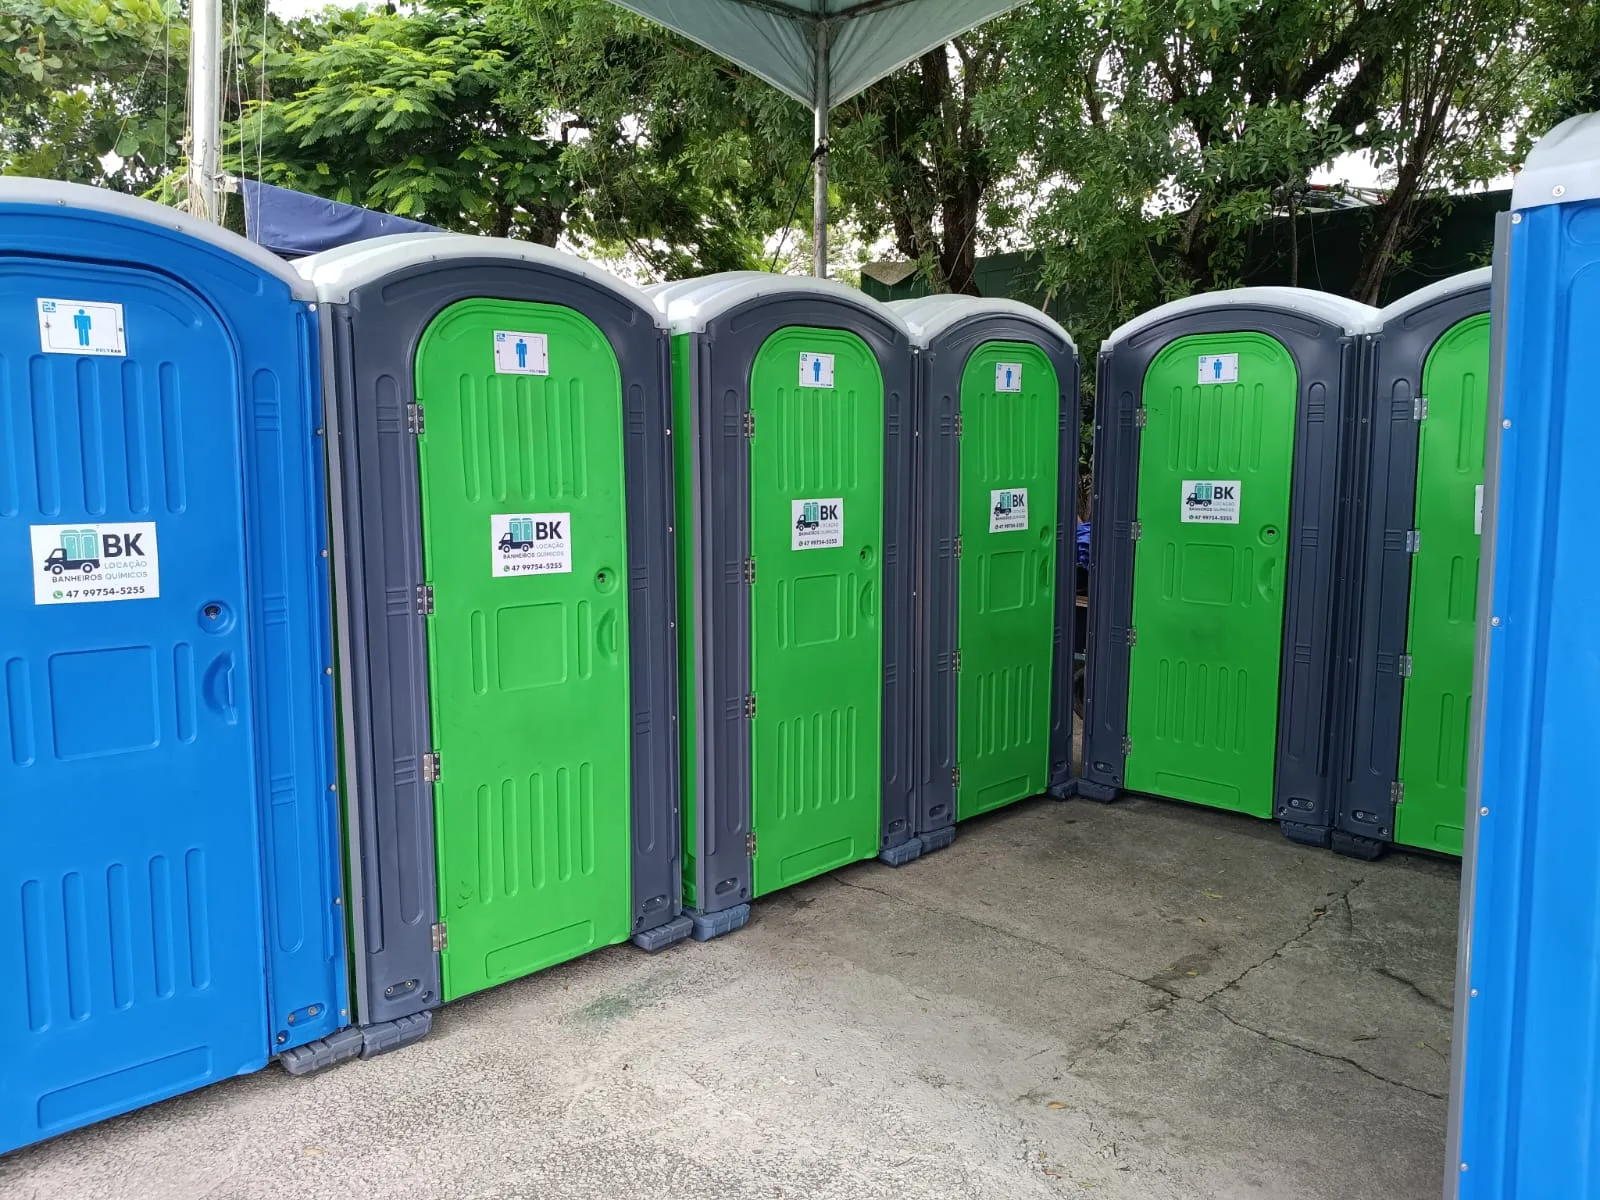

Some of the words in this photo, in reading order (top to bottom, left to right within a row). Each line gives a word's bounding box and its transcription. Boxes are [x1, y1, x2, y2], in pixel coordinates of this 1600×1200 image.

[1012, 493, 1025, 507] BK
[1214, 486, 1234, 500] BK
[820, 504, 838, 520] BK
[536, 521, 562, 540] BK
[102, 533, 145, 558] BK
[104, 559, 148, 570] LOCAÇÃO
[522, 562, 562, 570] 99754-5255
[51, 573, 103, 583] BANHEIROS
[104, 570, 148, 580] QUÍMICOS
[66, 590, 79, 598] 47
[82, 586, 145, 597] 99754-5255
